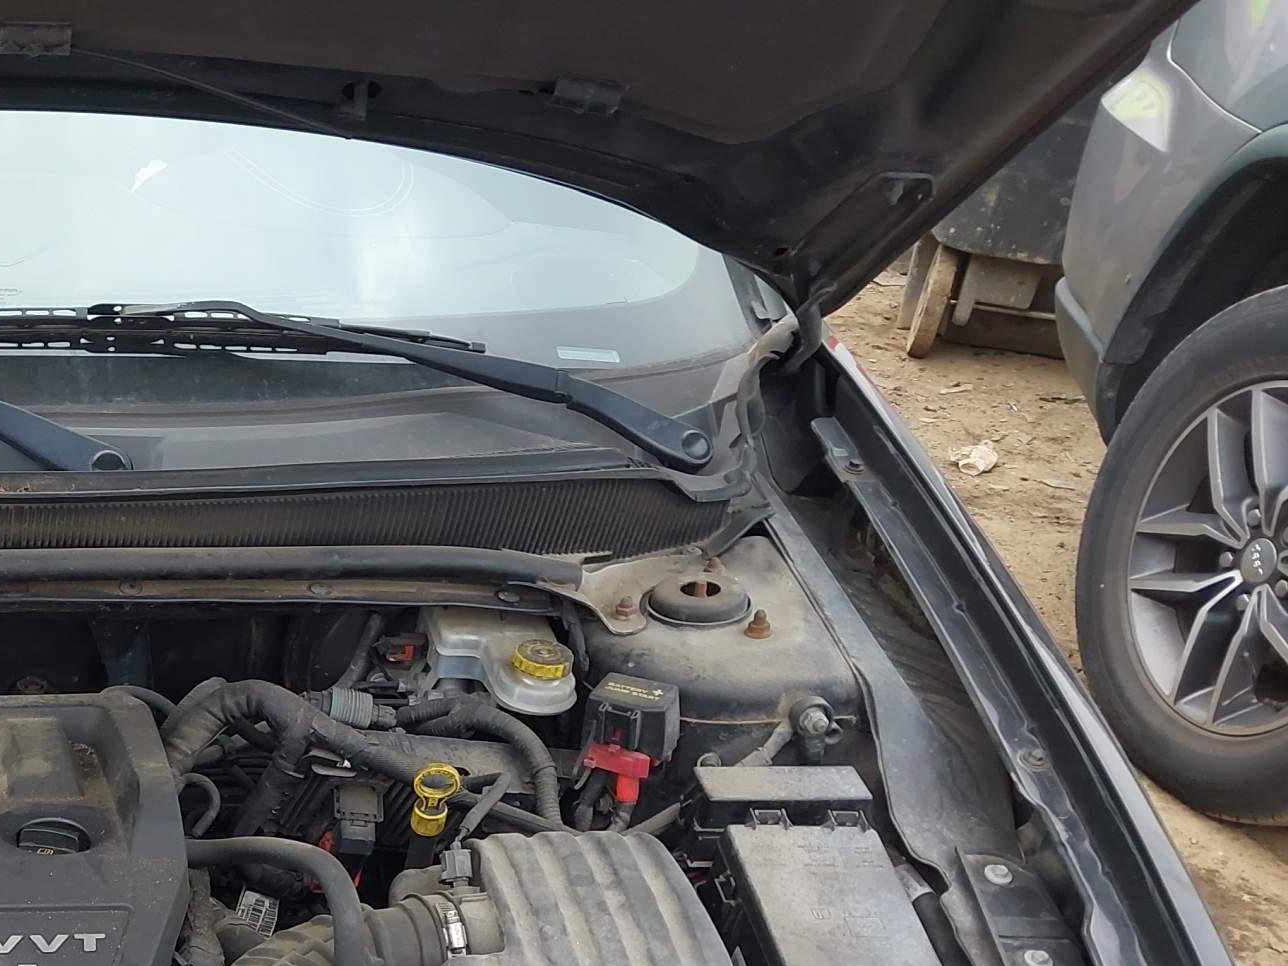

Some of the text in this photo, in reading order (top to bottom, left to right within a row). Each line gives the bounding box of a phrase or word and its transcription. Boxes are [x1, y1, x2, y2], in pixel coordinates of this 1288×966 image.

[604, 686, 661, 701] JUMP START
[607, 682, 649, 694] BATTERY
